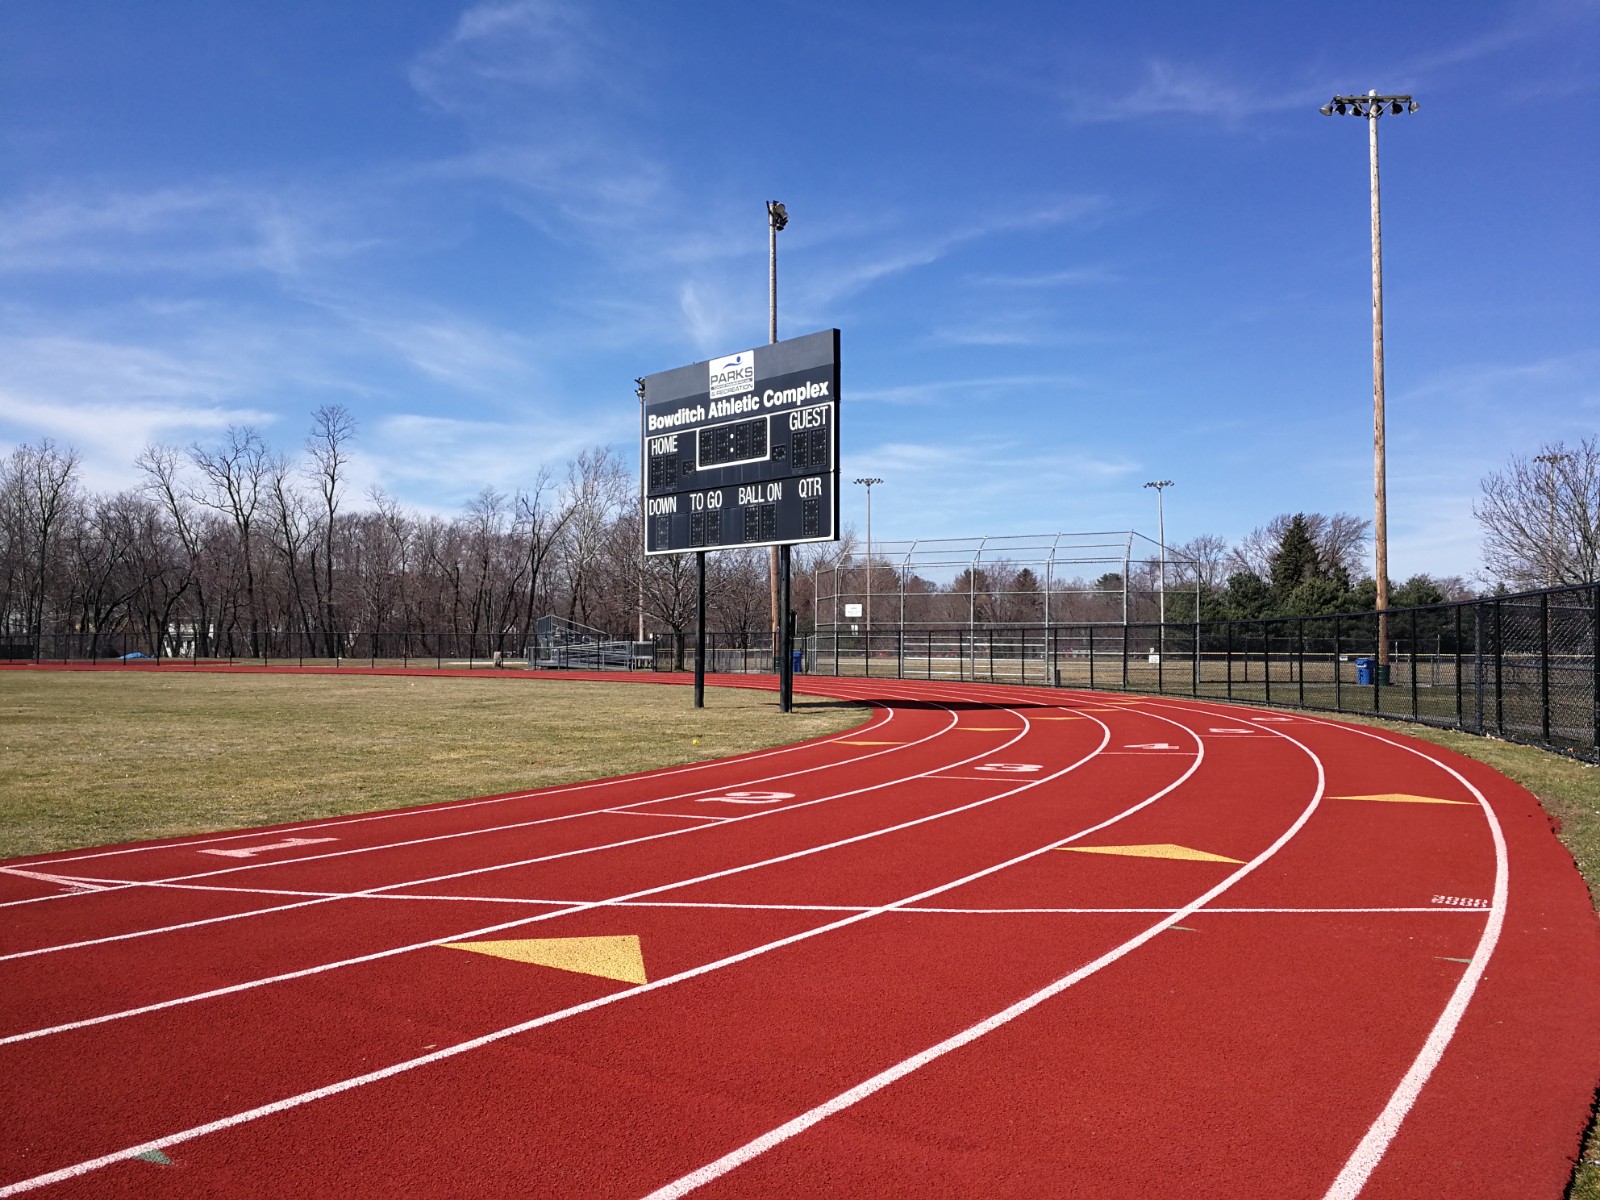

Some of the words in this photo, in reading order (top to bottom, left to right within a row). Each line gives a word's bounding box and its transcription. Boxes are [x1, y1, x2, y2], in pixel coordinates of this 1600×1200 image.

[711, 367, 753, 385] PARKS
[648, 405, 705, 431] Bowditch
[708, 394, 760, 419] Athletic
[763, 381, 829, 406] Complex
[789, 406, 828, 431] GUEST
[651, 435, 678, 455] HOME
[738, 485, 765, 505] BALL
[767, 482, 782, 502] ON
[798, 477, 822, 498] QTR
[649, 496, 677, 516] DOWN
[690, 493, 704, 511] TO
[707, 490, 723, 508] GO
[694, 791, 796, 804] 2
[196, 837, 341, 858] 1
